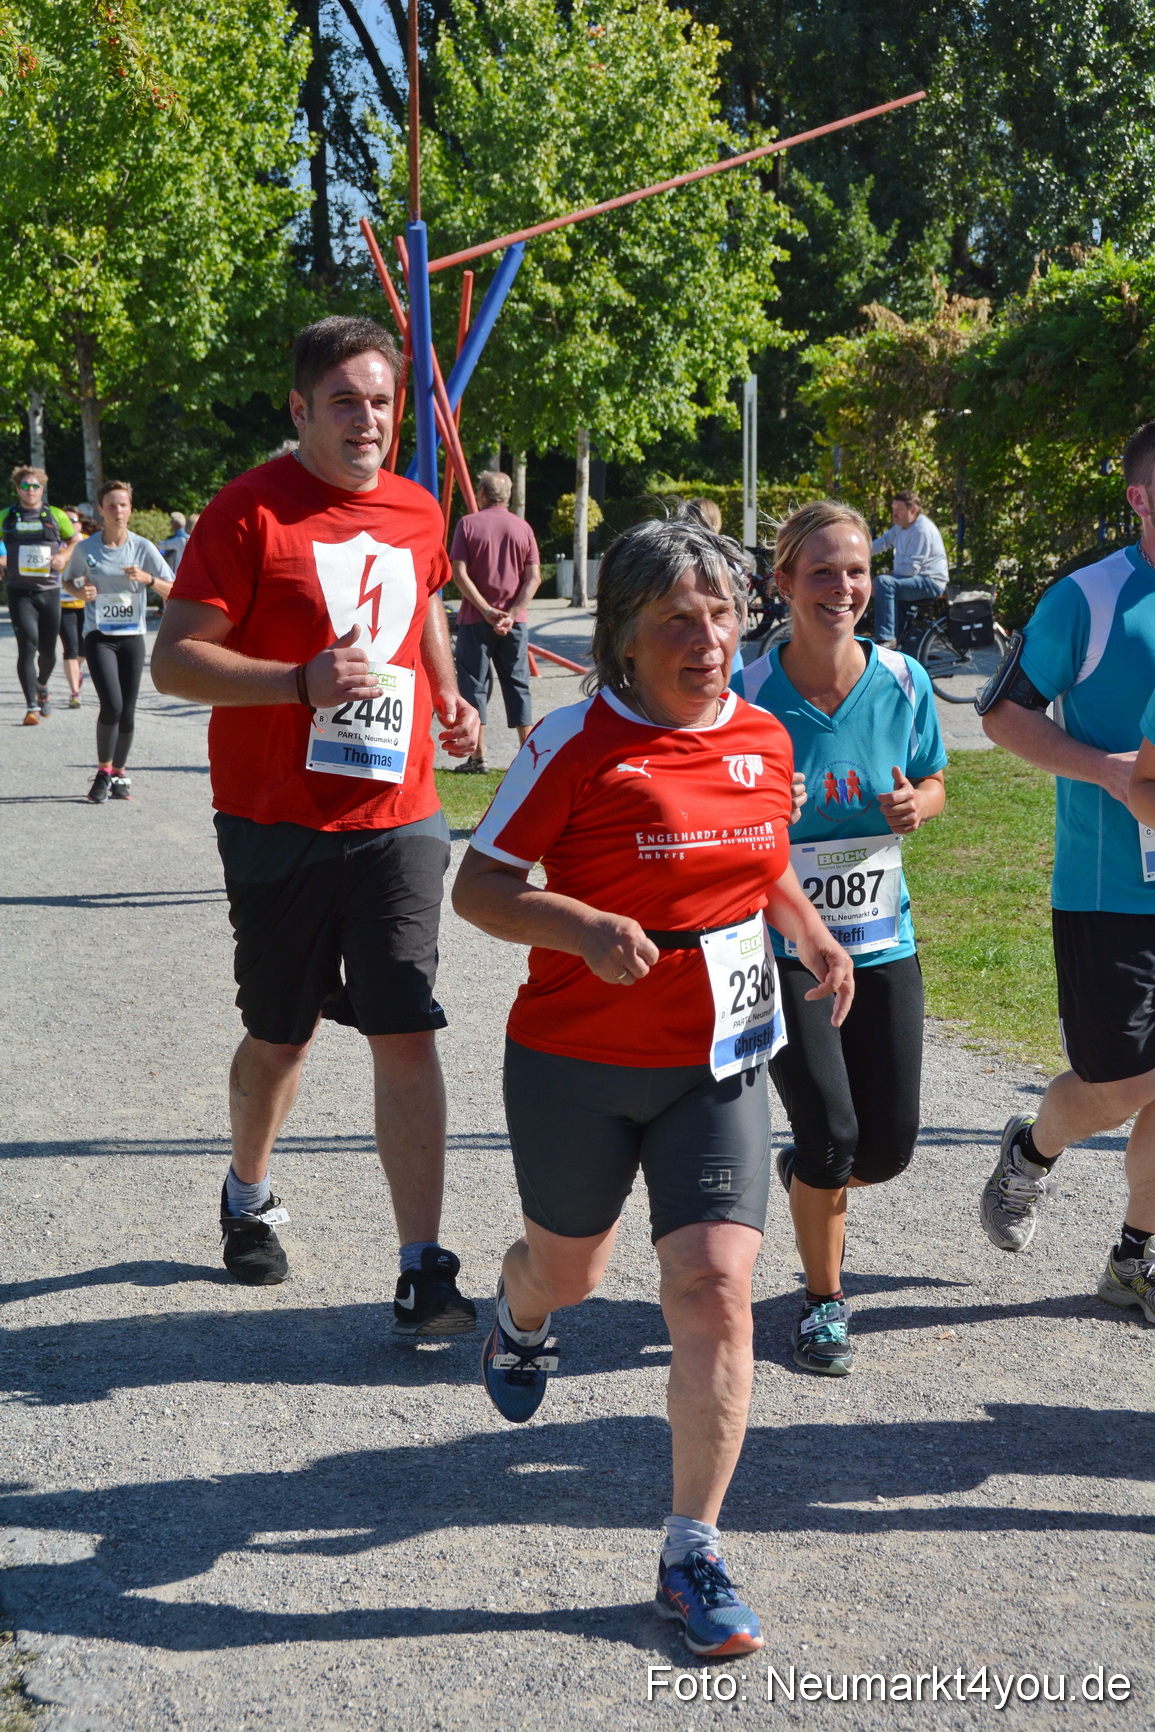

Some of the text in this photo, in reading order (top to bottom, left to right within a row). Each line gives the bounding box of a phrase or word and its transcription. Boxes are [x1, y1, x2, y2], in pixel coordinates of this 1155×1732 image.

[103, 605, 134, 618] 2099
[331, 697, 402, 733] 2449
[337, 730, 393, 744] PARTL Neumarkt
[343, 747, 392, 767] Thomas
[721, 829, 729, 838] &
[751, 841, 776, 851] Lauf
[638, 852, 685, 861] Amberg
[817, 848, 868, 866] BOCK
[803, 870, 885, 909] 2087
[838, 911, 870, 921] Neumarkt
[830, 926, 865, 944] Steffi
